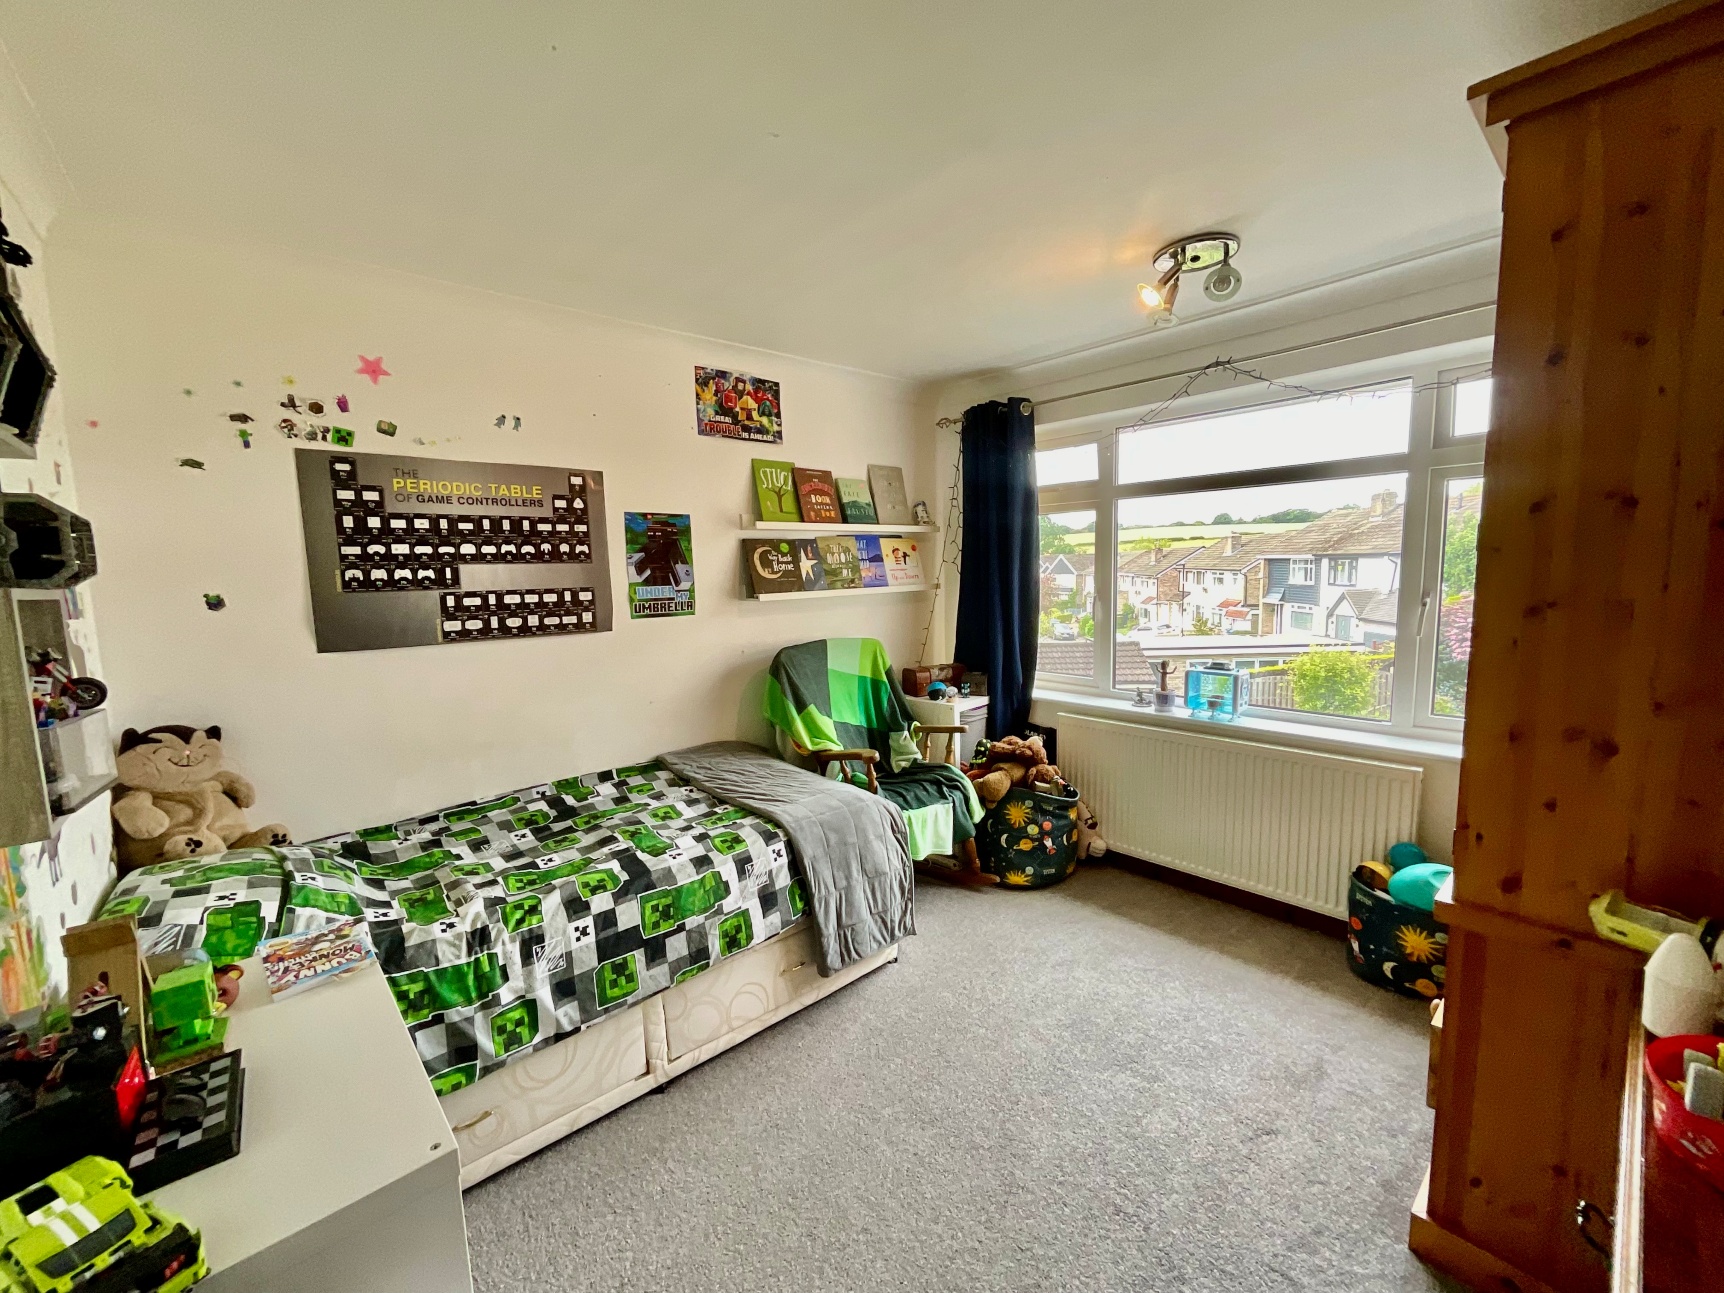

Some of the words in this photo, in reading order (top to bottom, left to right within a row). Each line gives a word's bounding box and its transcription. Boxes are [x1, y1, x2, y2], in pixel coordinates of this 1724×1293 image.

[703, 421, 742, 438] TROUBLE
[750, 432, 775, 442] AHEAD!
[392, 467, 419, 479] THE
[393, 478, 482, 496] PERIODIC
[488, 484, 543, 498] TABLE
[395, 493, 413, 503] OF
[416, 494, 453, 505] GAME
[457, 496, 544, 508] CONTROLLERS
[778, 553, 793, 562] Back
[826, 552, 853, 564] MOOSE
[773, 561, 795, 572] Home
[636, 586, 675, 599] UNDER
[675, 592, 689, 602] MY
[633, 600, 694, 614] UMBRELLA
[280, 951, 361, 984] BUNNY
